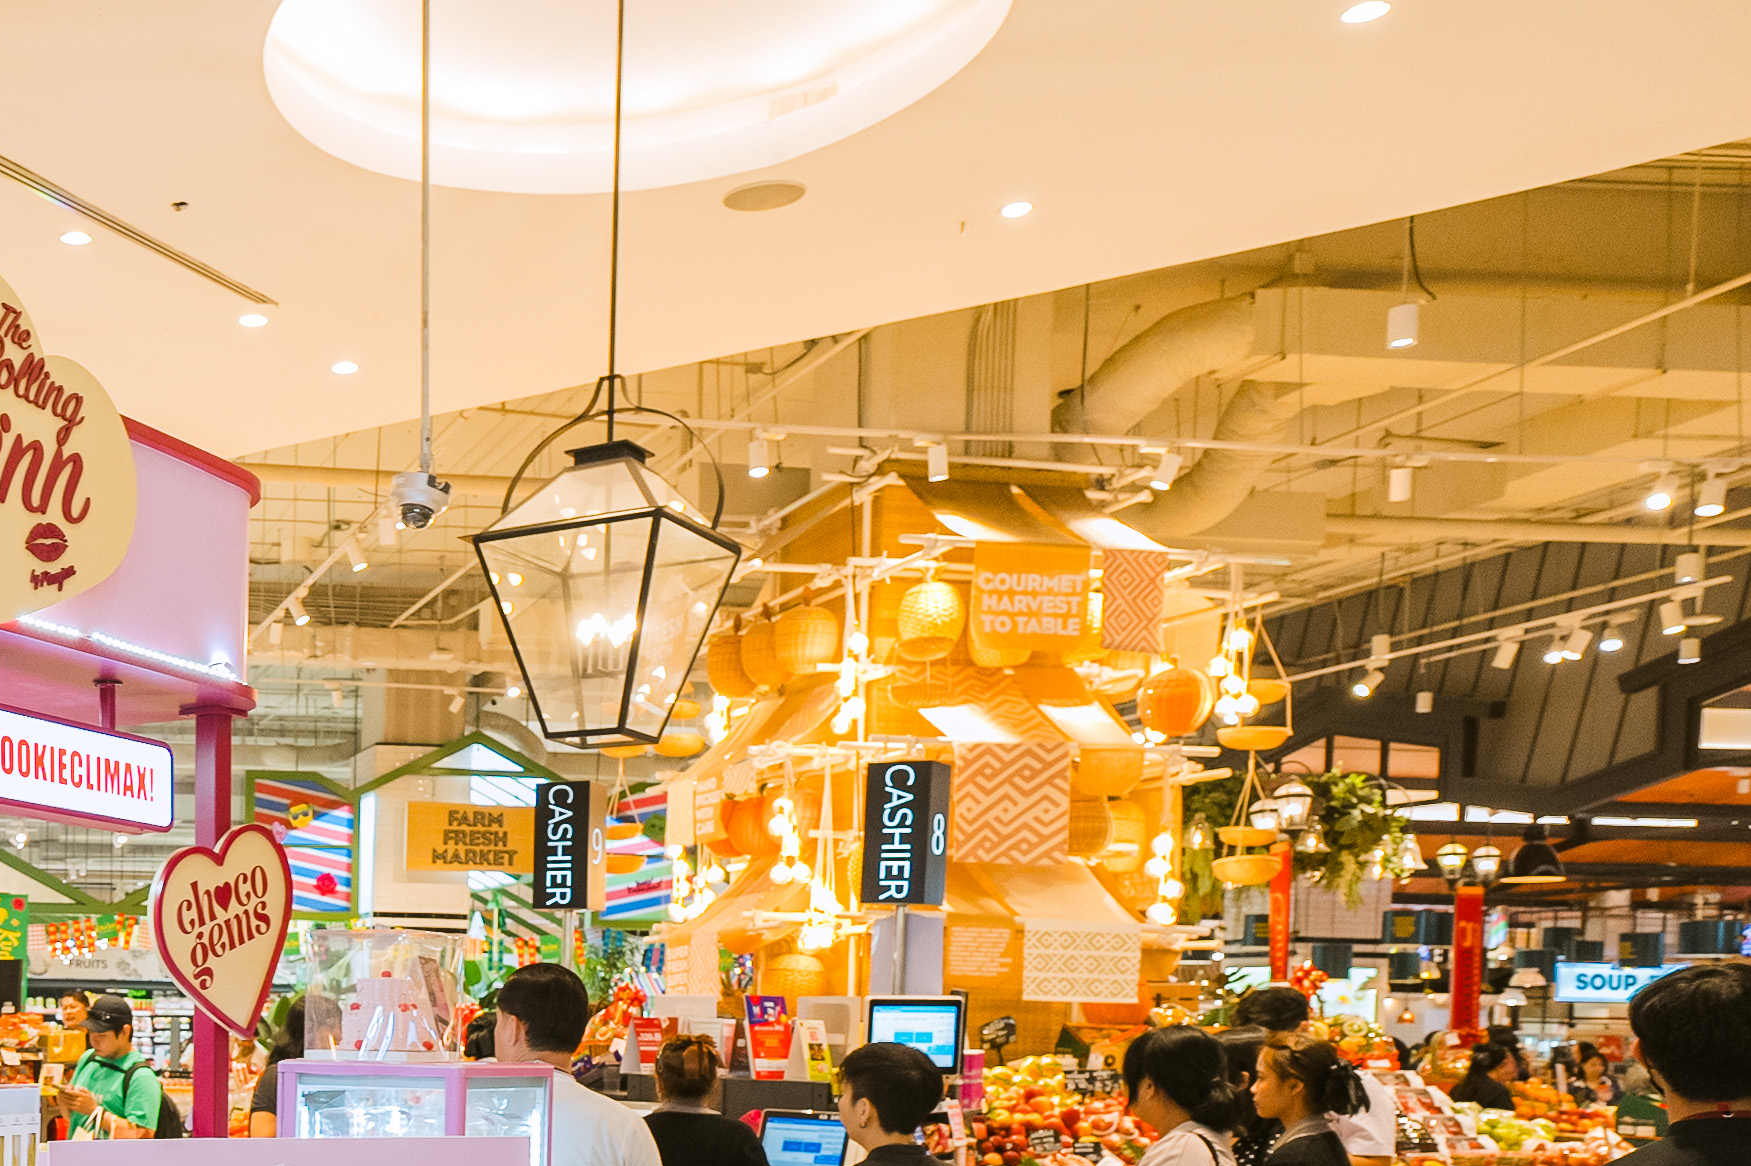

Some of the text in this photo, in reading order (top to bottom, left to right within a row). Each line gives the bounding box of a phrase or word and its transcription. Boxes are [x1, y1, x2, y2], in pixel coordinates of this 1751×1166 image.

[978, 571, 1087, 593] GOURMET
[981, 593, 1081, 615] HARVEST
[981, 615, 1080, 637] TO TABLE
[447, 809, 504, 829] FARM
[442, 829, 508, 848] FRESH
[878, 762, 945, 901] CASHIER 8
[545, 783, 602, 906] CASHIER 9
[432, 847, 518, 867] MARKET
[190, 901, 272, 988] gems
[70, 959, 108, 969] FRUITS
[1575, 972, 1638, 992] SOUP
